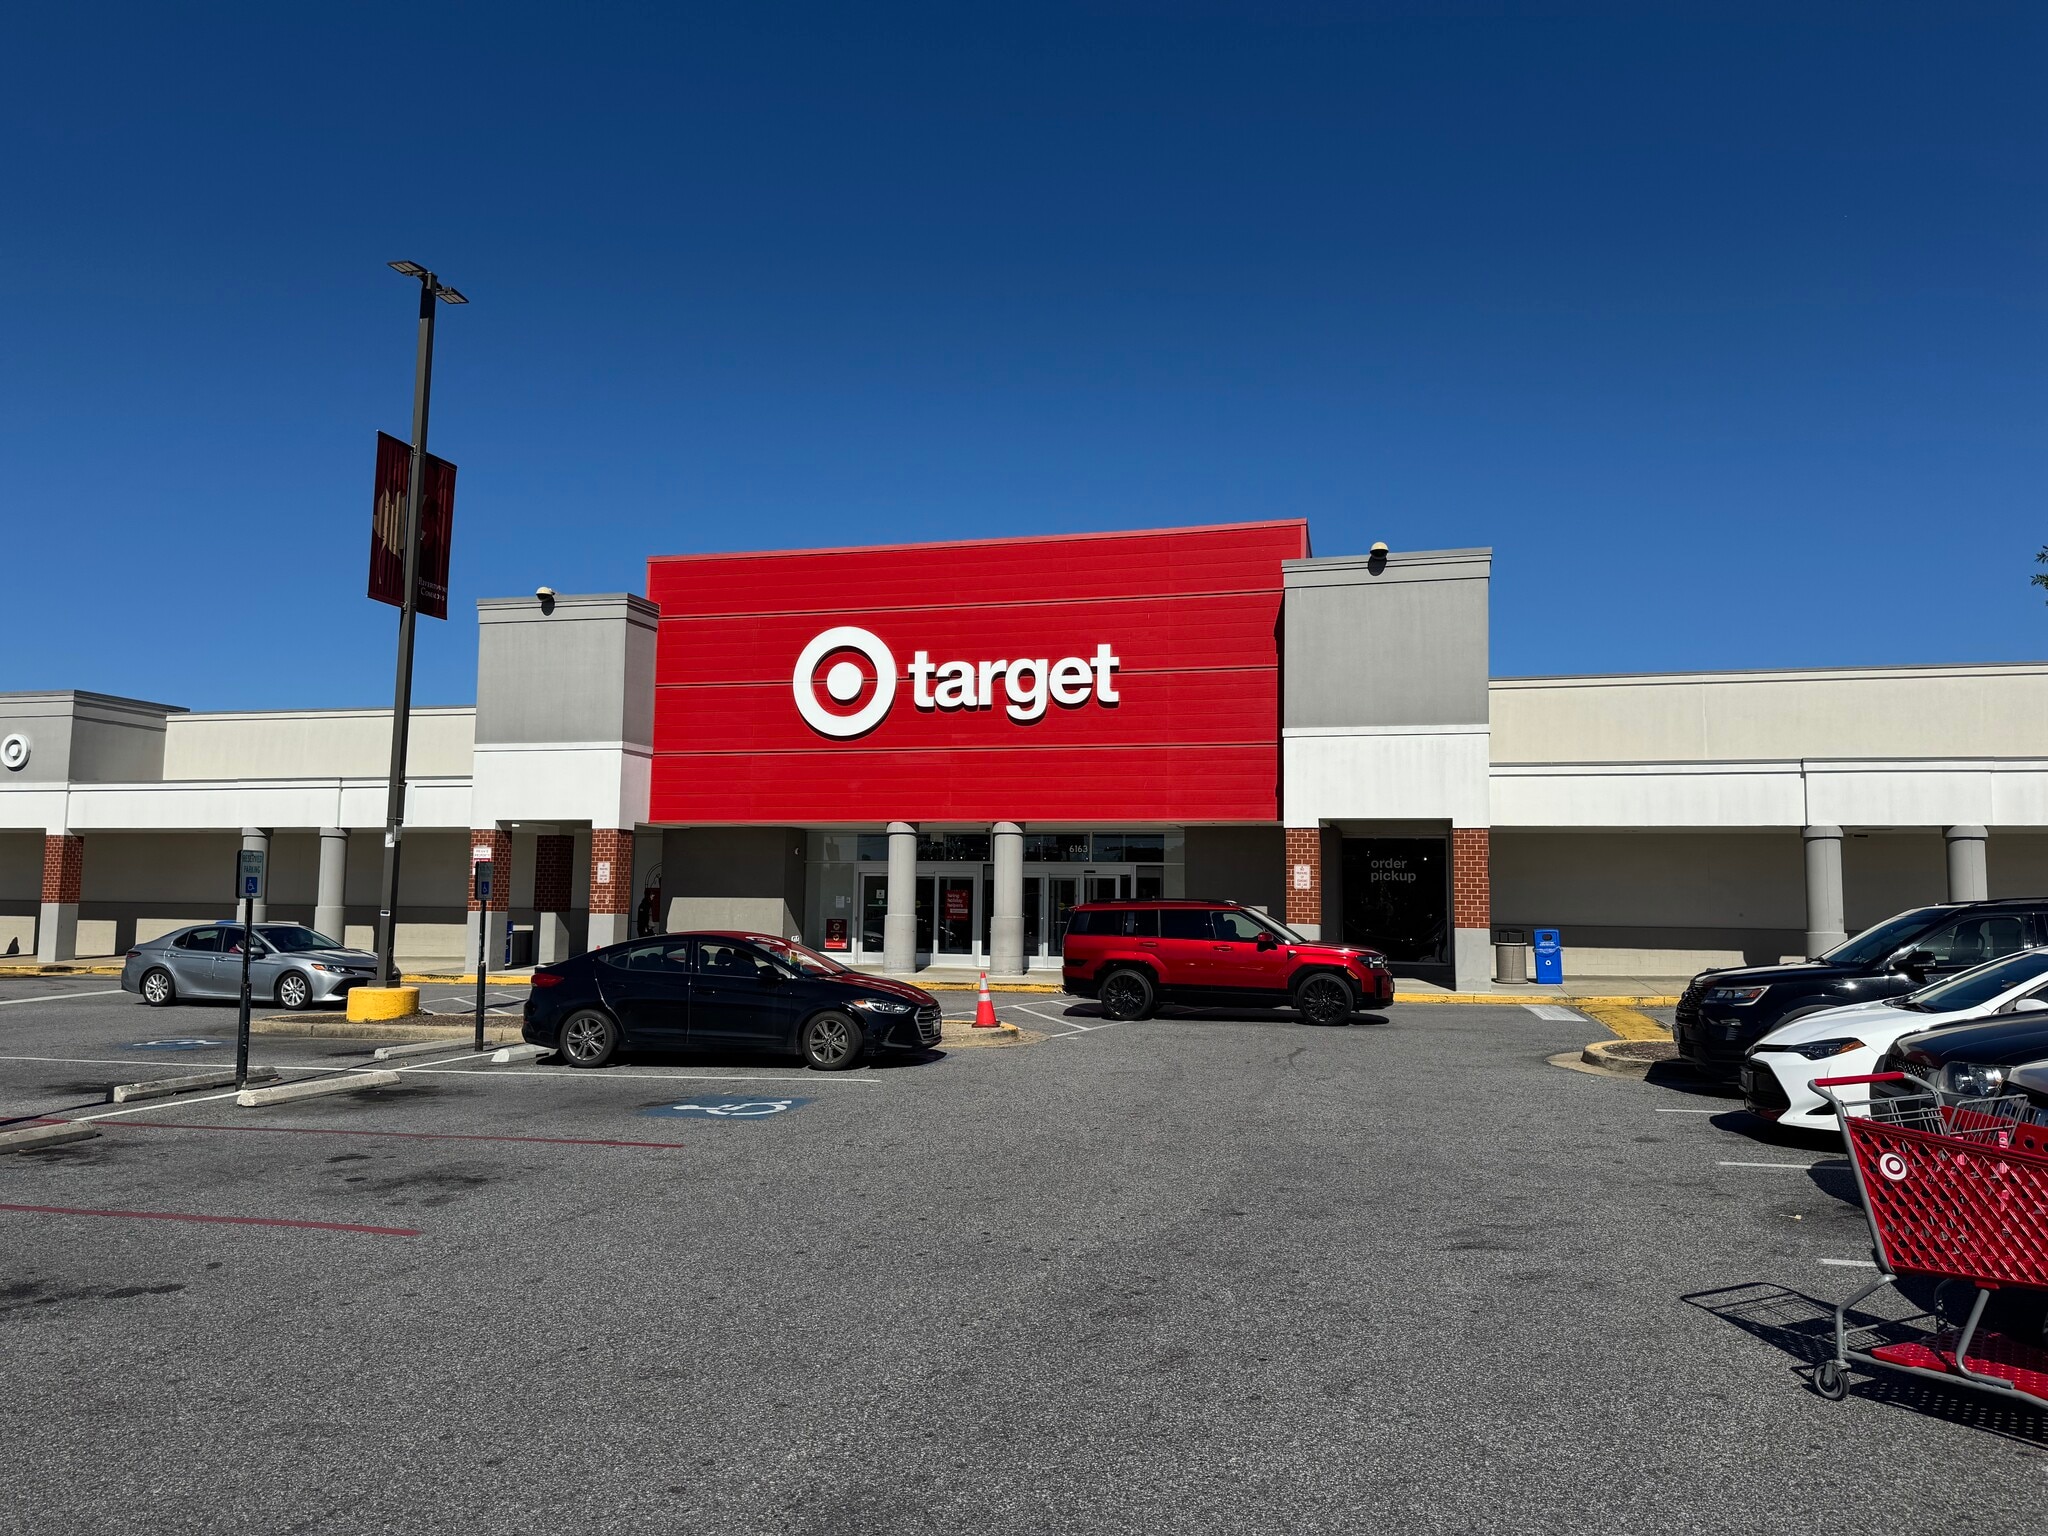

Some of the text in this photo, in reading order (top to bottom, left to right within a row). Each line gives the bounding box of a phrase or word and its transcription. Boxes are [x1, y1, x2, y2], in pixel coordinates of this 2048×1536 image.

[908, 643, 1120, 722] target
[1069, 844, 1089, 853] 6163
[242, 854, 262, 863] RESERVED
[1371, 857, 1408, 868] order
[243, 865, 261, 874] PARKING
[1371, 869, 1416, 883] pickup
